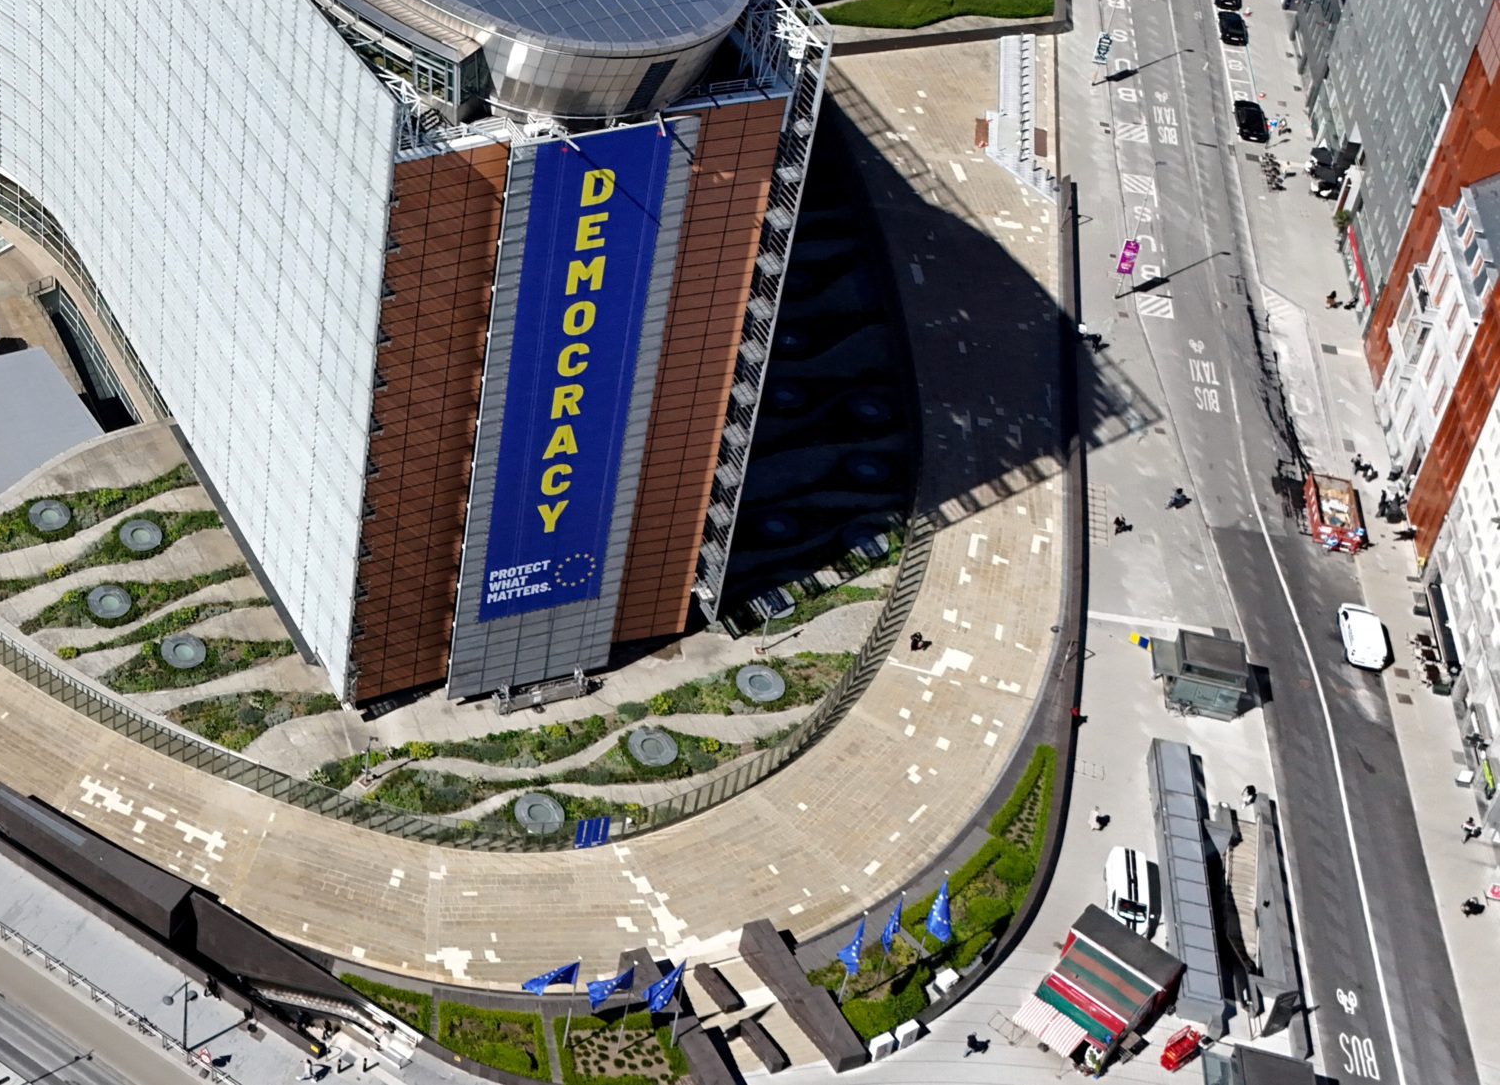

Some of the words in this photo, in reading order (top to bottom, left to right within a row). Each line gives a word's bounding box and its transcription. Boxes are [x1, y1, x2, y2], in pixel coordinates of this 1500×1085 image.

[1112, 29, 1138, 103] BUS
[1153, 105, 1178, 126] TAXI
[1157, 126, 1178, 145] BUS
[537, 168, 616, 533] DEMOCRACY
[1188, 358, 1220, 386] TAXI
[1193, 387, 1220, 413] BUS
[489, 559, 551, 582] PROTECT
[486, 582, 552, 604] MATTERS.
[488, 575, 529, 592] WHAT
[1339, 1032, 1380, 1081] BUS
